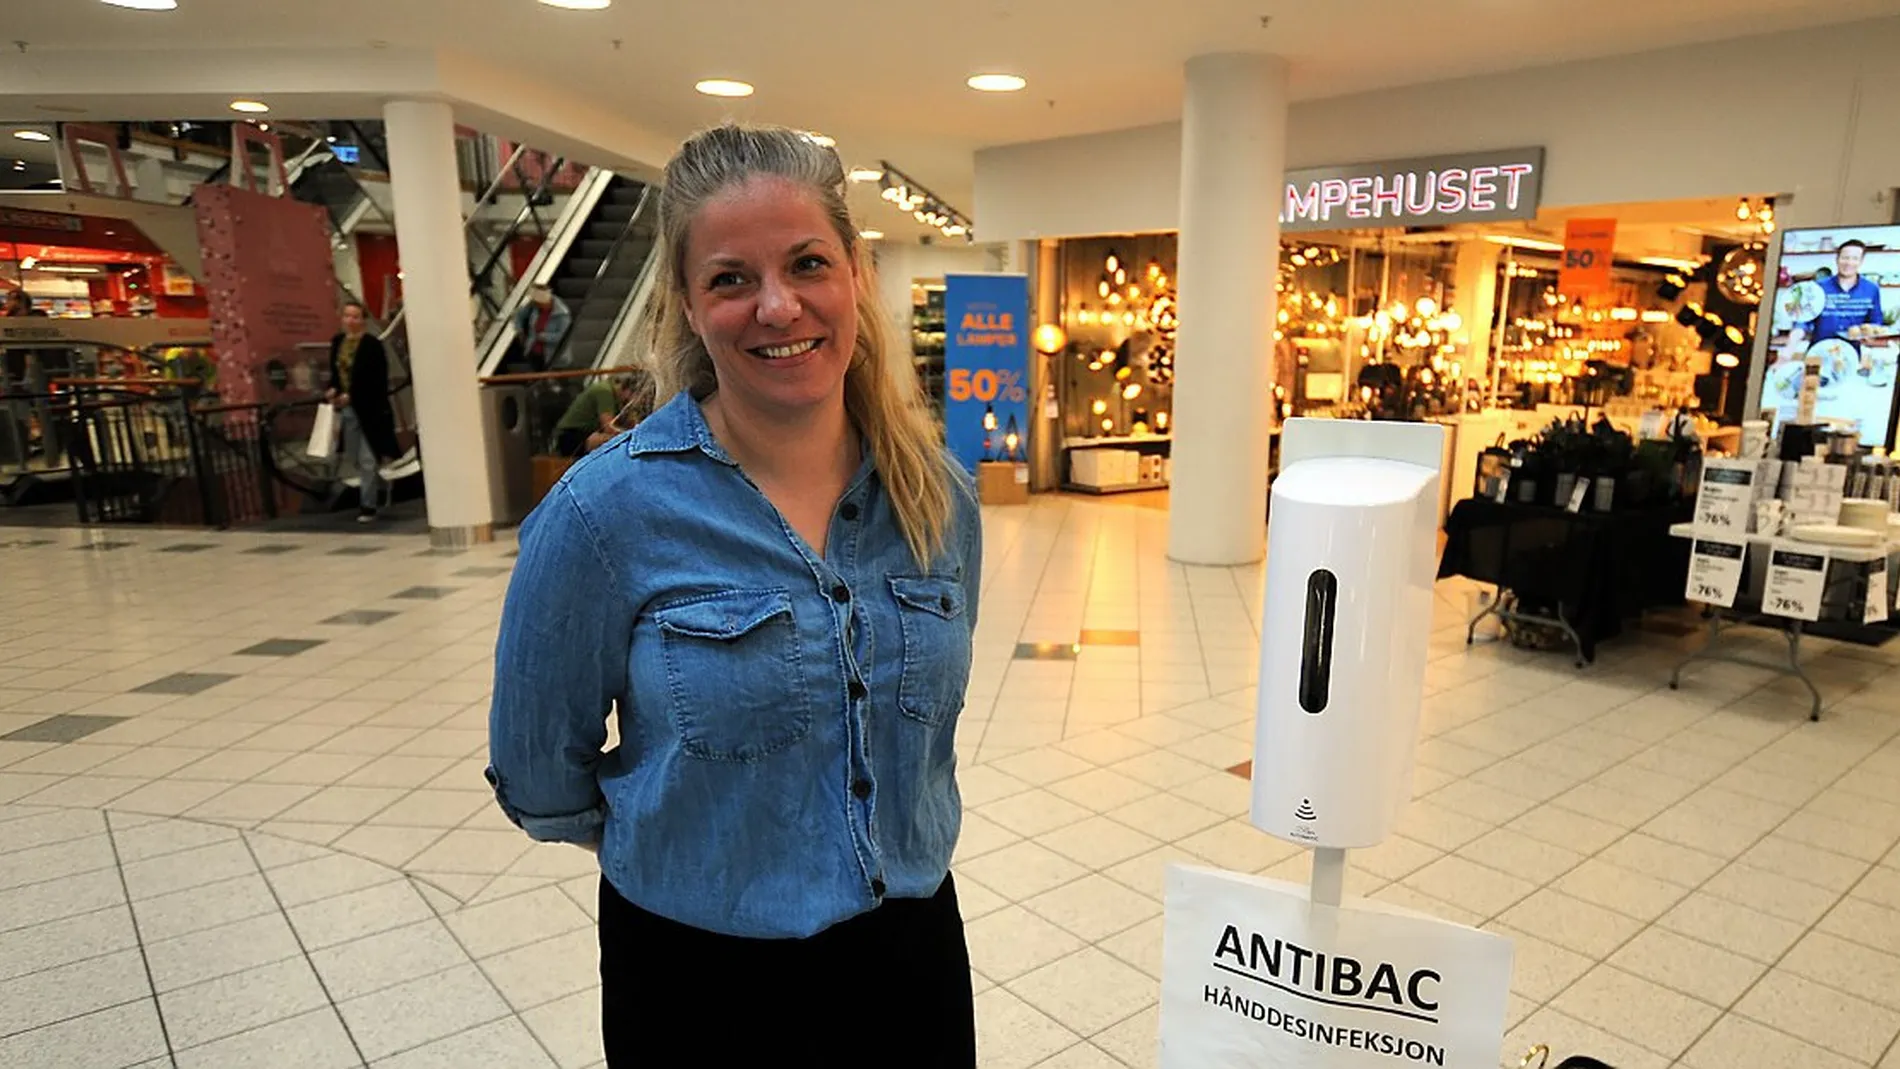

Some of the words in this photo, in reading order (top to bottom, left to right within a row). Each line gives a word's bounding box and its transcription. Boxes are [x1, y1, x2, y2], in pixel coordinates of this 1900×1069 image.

[1278, 163, 1533, 223] MPEHUSET
[961, 313, 1012, 330] ALLE
[948, 368, 1025, 403] 50%
[1213, 924, 1441, 1012] ANTIBAC
[1203, 984, 1446, 1067] HÅNDDESINFEKSJON
